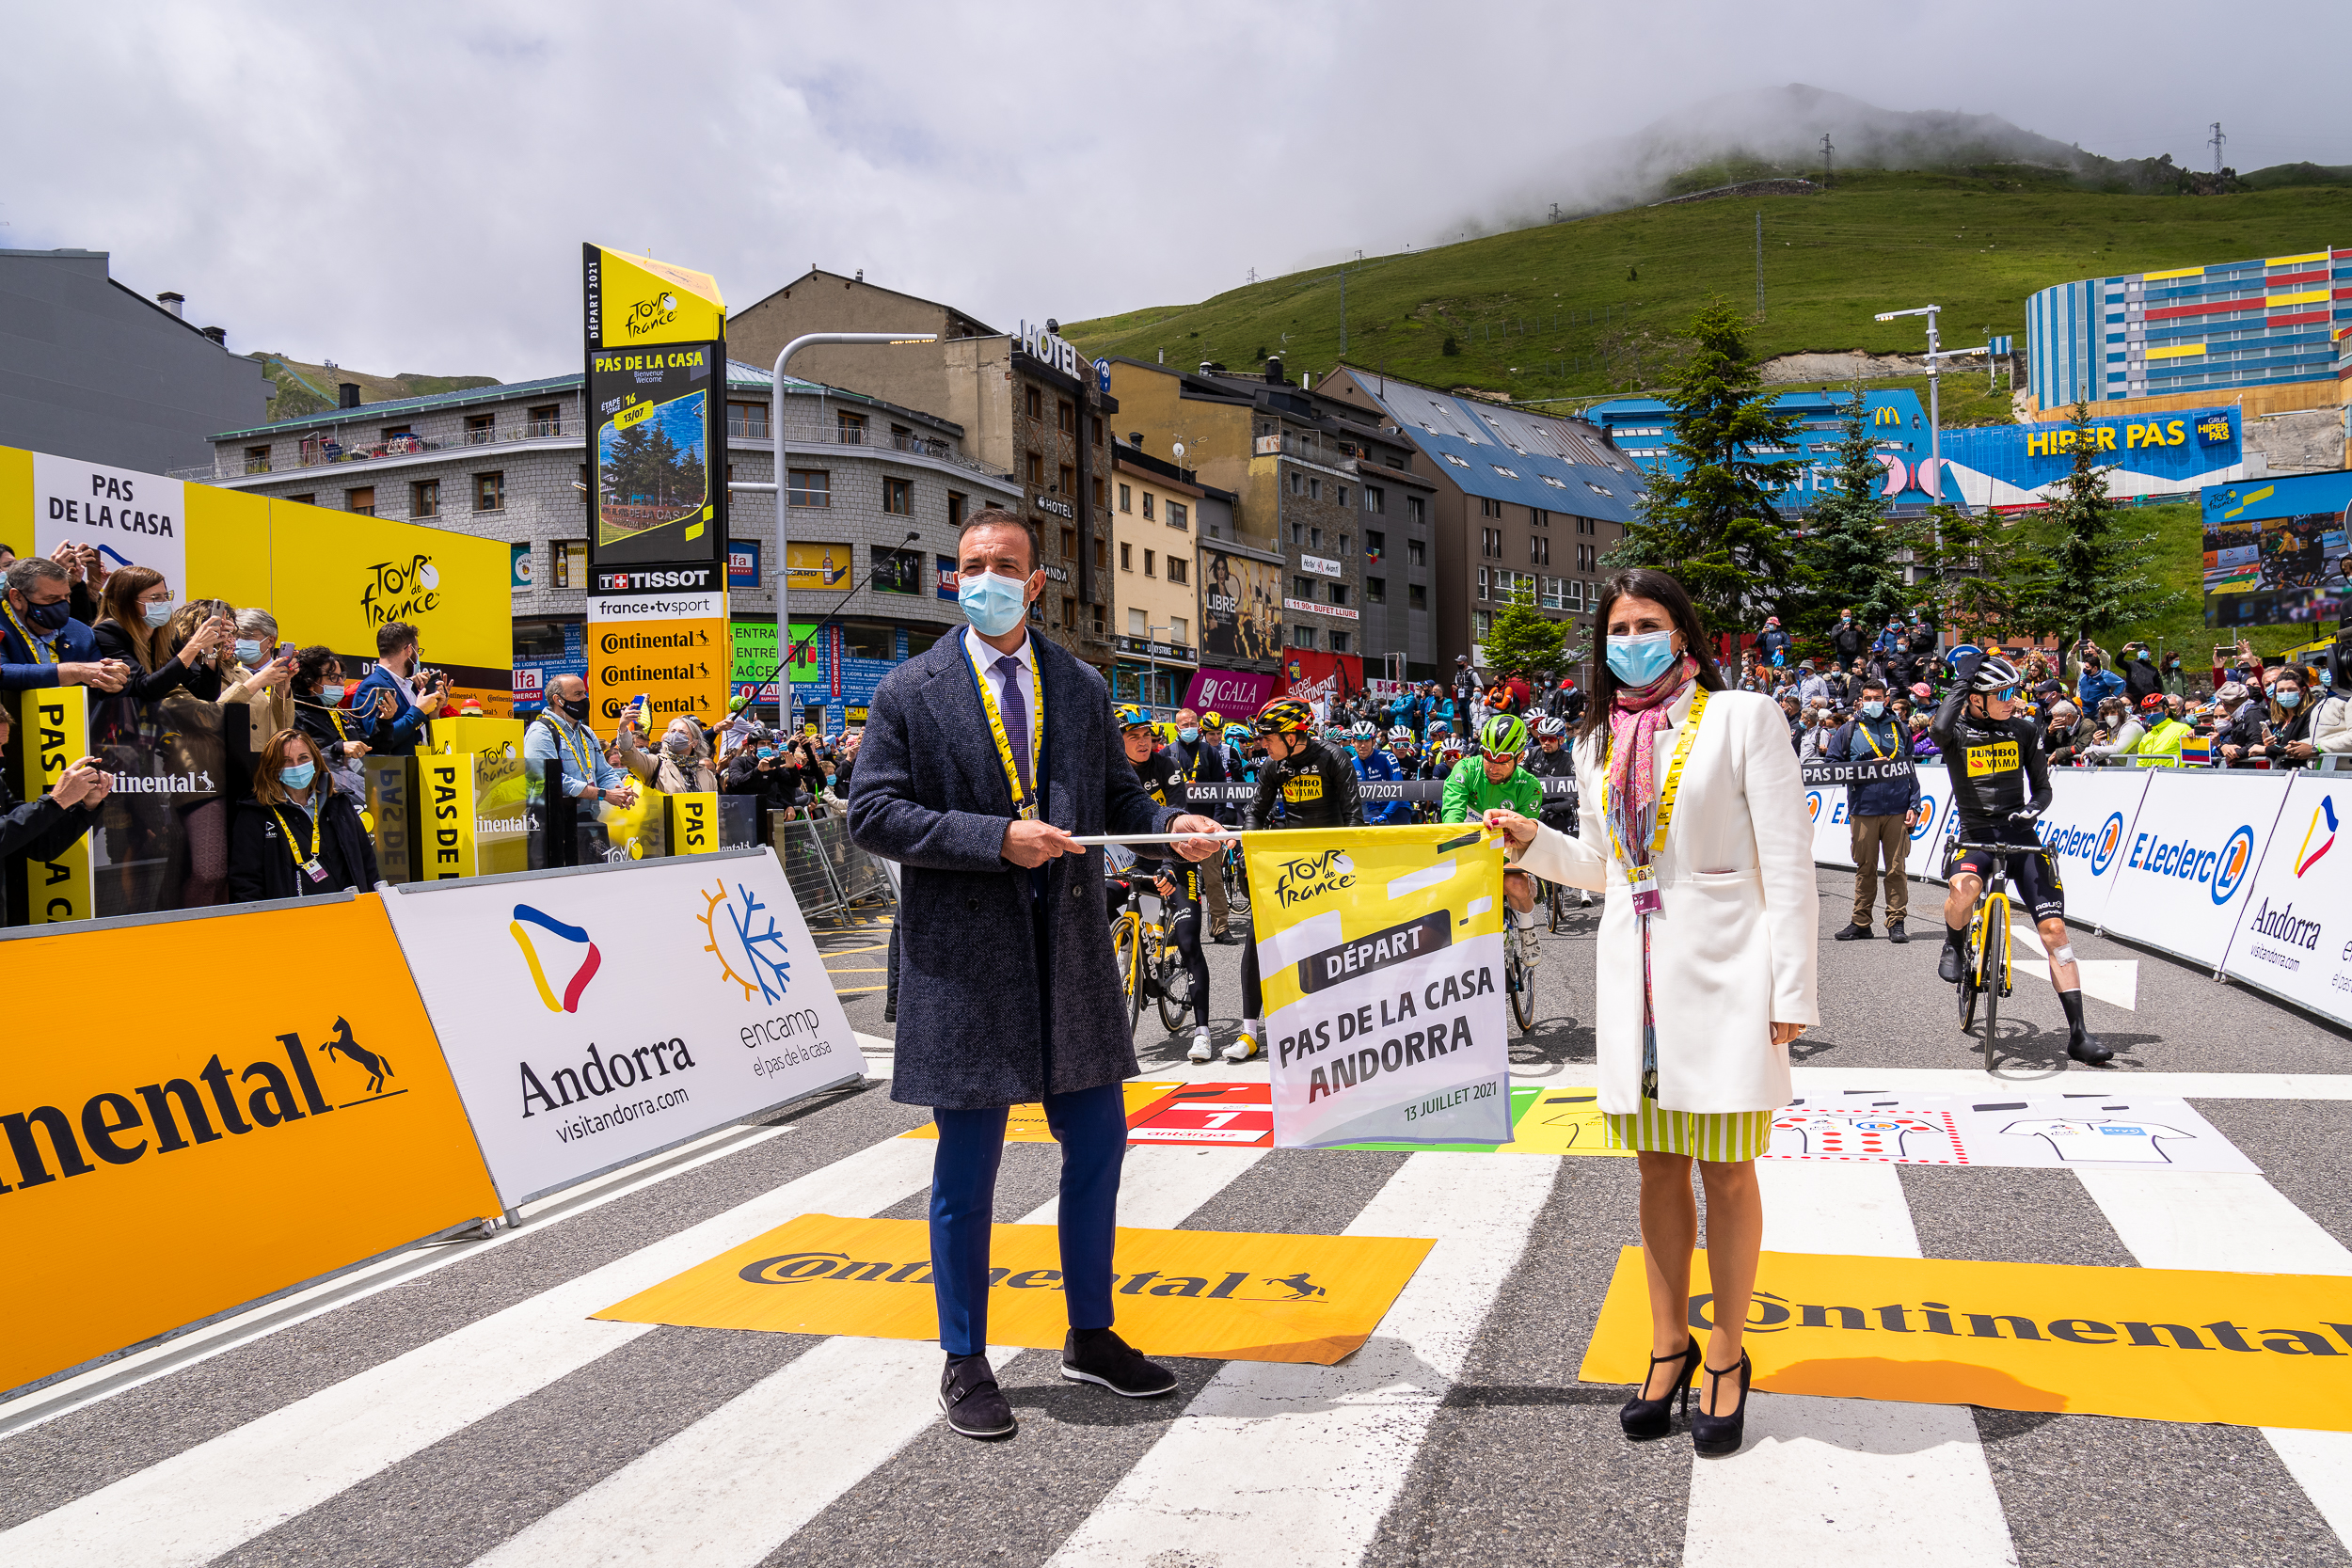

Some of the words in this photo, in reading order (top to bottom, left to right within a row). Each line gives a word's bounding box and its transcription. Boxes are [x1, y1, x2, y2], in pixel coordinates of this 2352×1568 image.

[589, 261, 597, 289] 2021
[589, 294, 599, 339] DÉPART
[1021, 319, 1081, 380] HOTEL
[596, 357, 622, 372] PAS
[625, 356, 643, 371] DE
[646, 354, 664, 369] LA
[668, 351, 704, 368] CASA
[633, 370, 664, 378] Bienvenue
[600, 396, 621, 412] ÉTAPE
[625, 392, 636, 406] 16
[623, 407, 644, 423] 13/07
[2126, 420, 2185, 449] PAS
[2198, 422, 2229, 434] HIPER
[2209, 431, 2230, 440] PAS
[92, 473, 134, 502] PAS
[49, 496, 78, 523] DE
[85, 502, 114, 529] LA
[119, 509, 173, 538] CASA
[629, 509, 640, 518] DE
[642, 509, 655, 519] LA
[1046, 499, 1073, 518] HOTEL
[729, 555, 747, 565] lfa
[410, 581, 421, 595] de
[629, 570, 709, 589] TISSOT
[1206, 593, 1236, 613] LIBRE
[1313, 604, 1334, 614] BUFET
[1336, 609, 1357, 618] LLIURE
[600, 631, 695, 654] Continental
[736, 628, 793, 639] ENTRAA
[737, 645, 779, 658] ENTRÉ
[514, 671, 535, 688] lfa
[601, 663, 695, 687] Continental
[1217, 680, 1257, 704] GALA
[601, 696, 695, 719] Conental
[1214, 703, 1253, 711] PERFUMERIES
[39, 704, 67, 772] PAS
[1970, 749, 2017, 758] JUMBO
[1986, 759, 2017, 768] VISMA
[1803, 768, 1831, 782] PAS
[1835, 767, 1853, 780] DE
[1858, 766, 1878, 779] LA
[1882, 762, 1910, 778] CASA
[434, 767, 457, 820] PAS
[1186, 786, 1218, 800] CASA
[1359, 784, 1403, 800] 07/2021
[685, 802, 705, 846] PAS
[437, 829, 460, 863] DE
[2128, 832, 2215, 883] E.Leclerc
[1324, 869, 1335, 879] de
[1186, 871, 1198, 901] JUMBO
[2250, 896, 2321, 951] Andorra
[1326, 926, 1423, 980] DÉPART
[2250, 942, 2300, 973] visitandorra.com
[739, 1007, 819, 1049] encamp
[1279, 1021, 1330, 1069] PAS
[1337, 1005, 1374, 1043] DE
[1380, 990, 1417, 1028] LA
[1424, 966, 1495, 1015] CASA
[754, 1057, 765, 1077] el
[766, 1053, 785, 1079] pas
[785, 1046, 800, 1066] de
[801, 1042, 810, 1062] la
[809, 1039, 832, 1059] casa
[1309, 1014, 1474, 1104] ANDORRA
[519, 1037, 695, 1118] Andorra
[1404, 1106, 1417, 1122] 13
[1420, 1090, 1469, 1117] JUILLET
[1472, 1081, 1498, 1101] 2021
[556, 1086, 690, 1143] visitandorra.com
[2105, 1127, 2134, 1136] Krys
